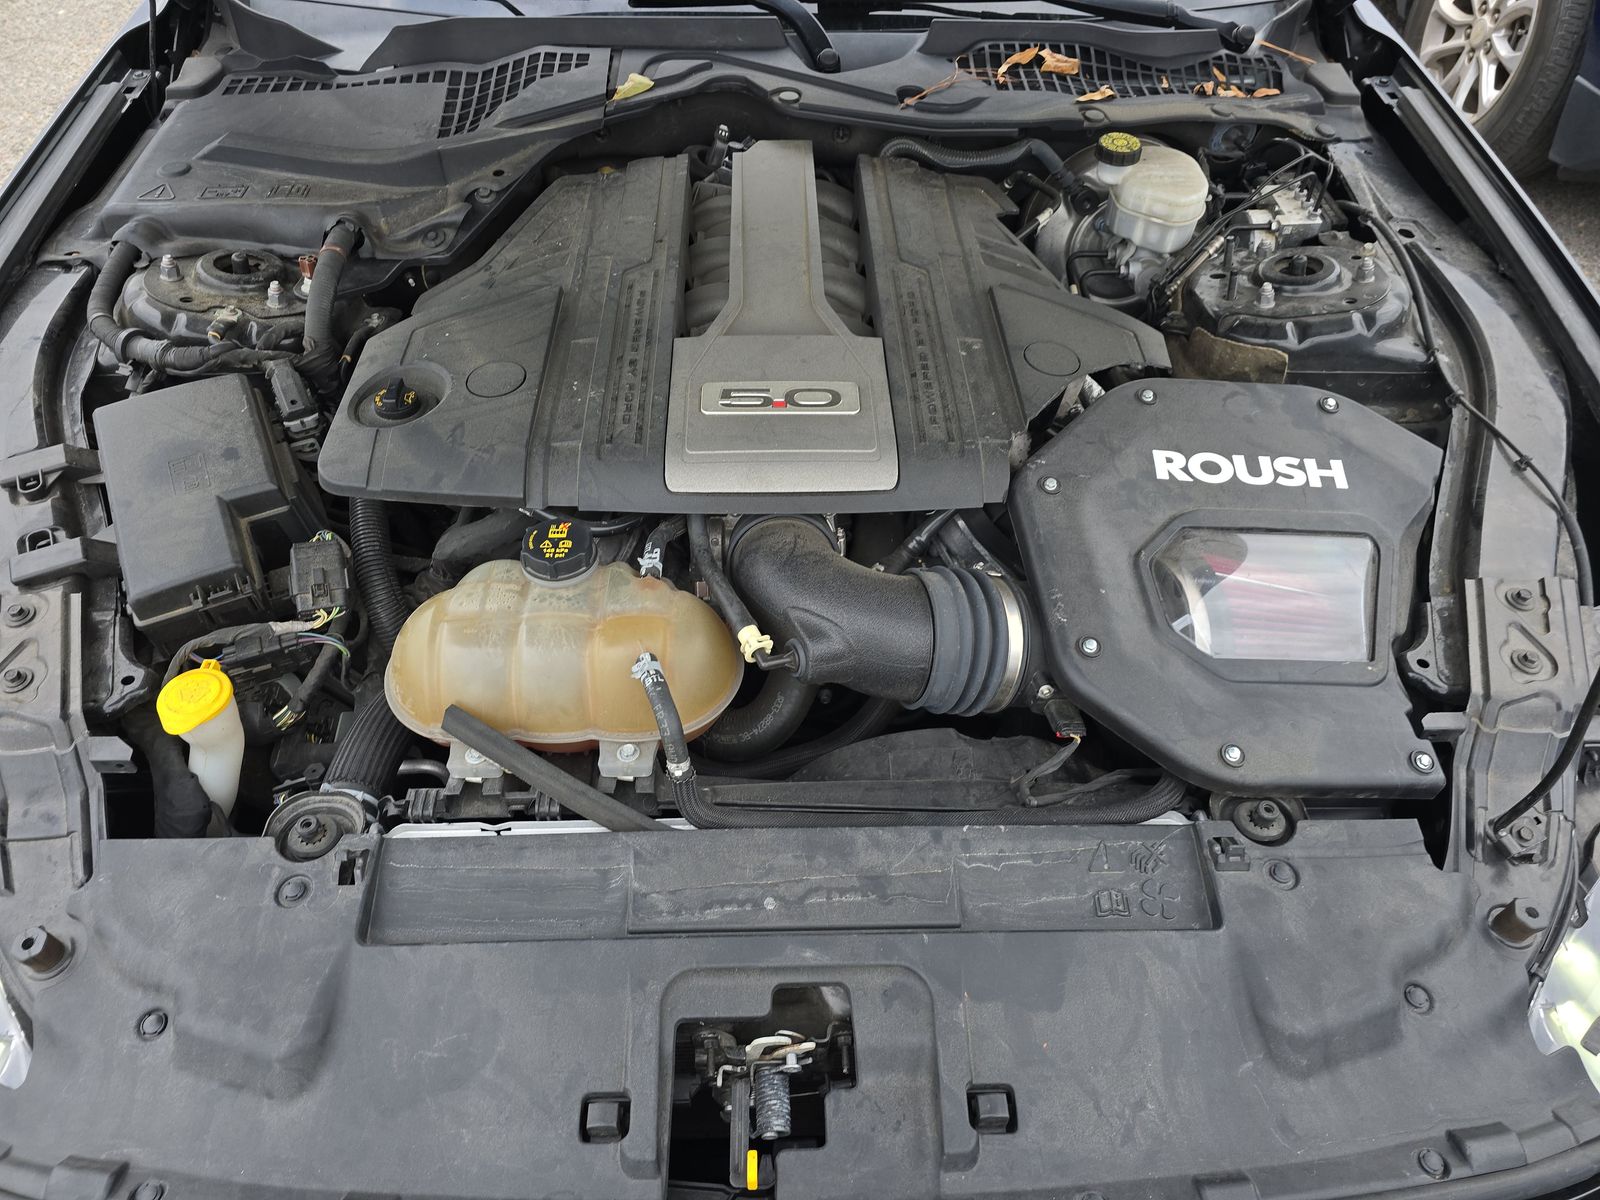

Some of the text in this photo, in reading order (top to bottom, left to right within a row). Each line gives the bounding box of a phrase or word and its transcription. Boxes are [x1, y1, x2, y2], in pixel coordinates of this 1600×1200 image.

[622, 382, 635, 425] FORD
[718, 388, 842, 409] 5.0
[1152, 449, 1349, 490] ROUSH
